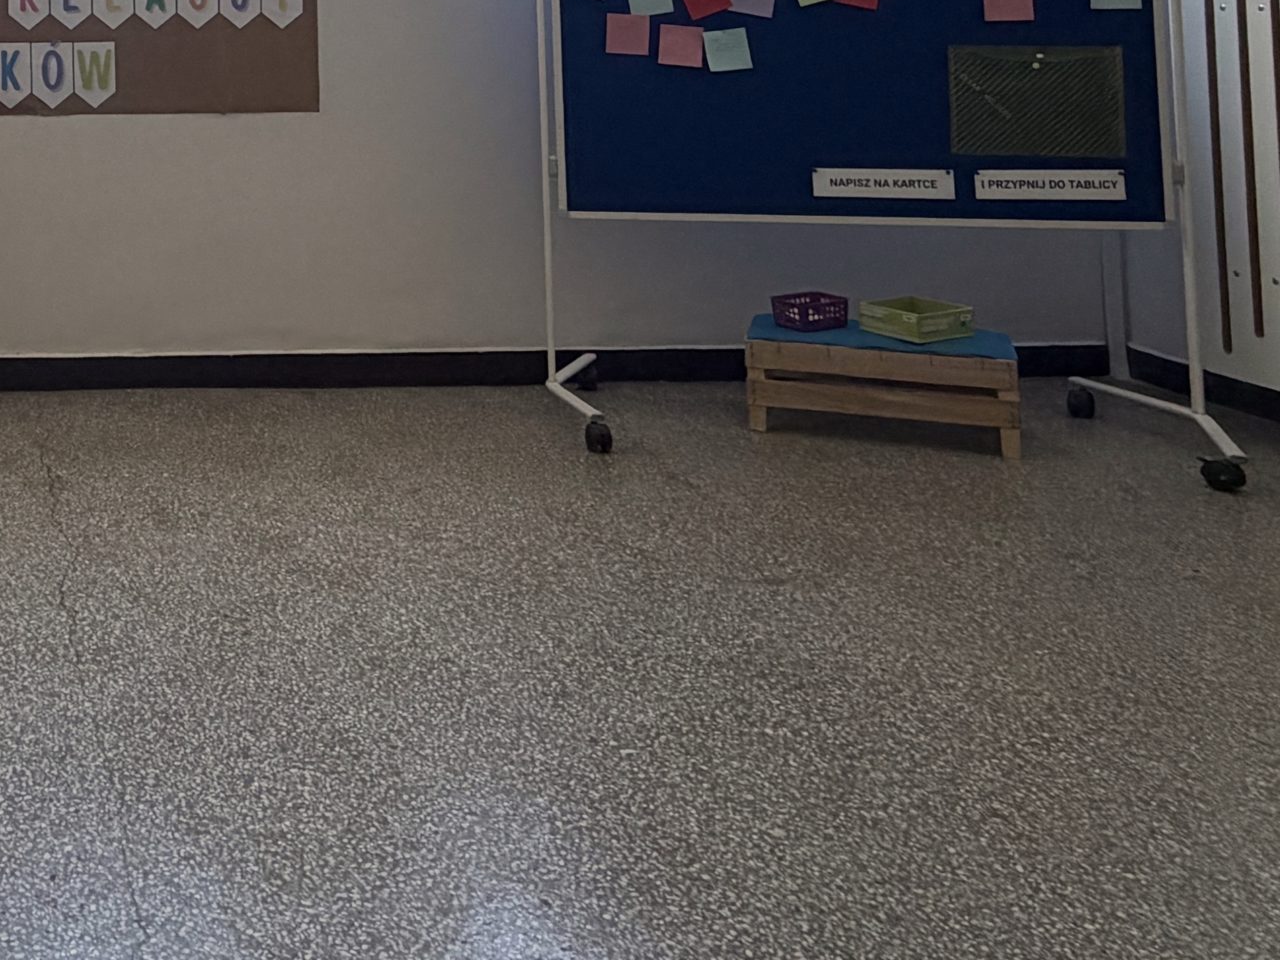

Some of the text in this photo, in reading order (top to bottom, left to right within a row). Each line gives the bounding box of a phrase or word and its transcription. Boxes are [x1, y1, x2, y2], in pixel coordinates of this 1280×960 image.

[829, 177, 938, 191] NAPISZ NA KARTCE
[988, 179, 1046, 190] PRZYPNIJ
[1049, 179, 1066, 190] DO
[1069, 179, 1118, 190] TABLICY
